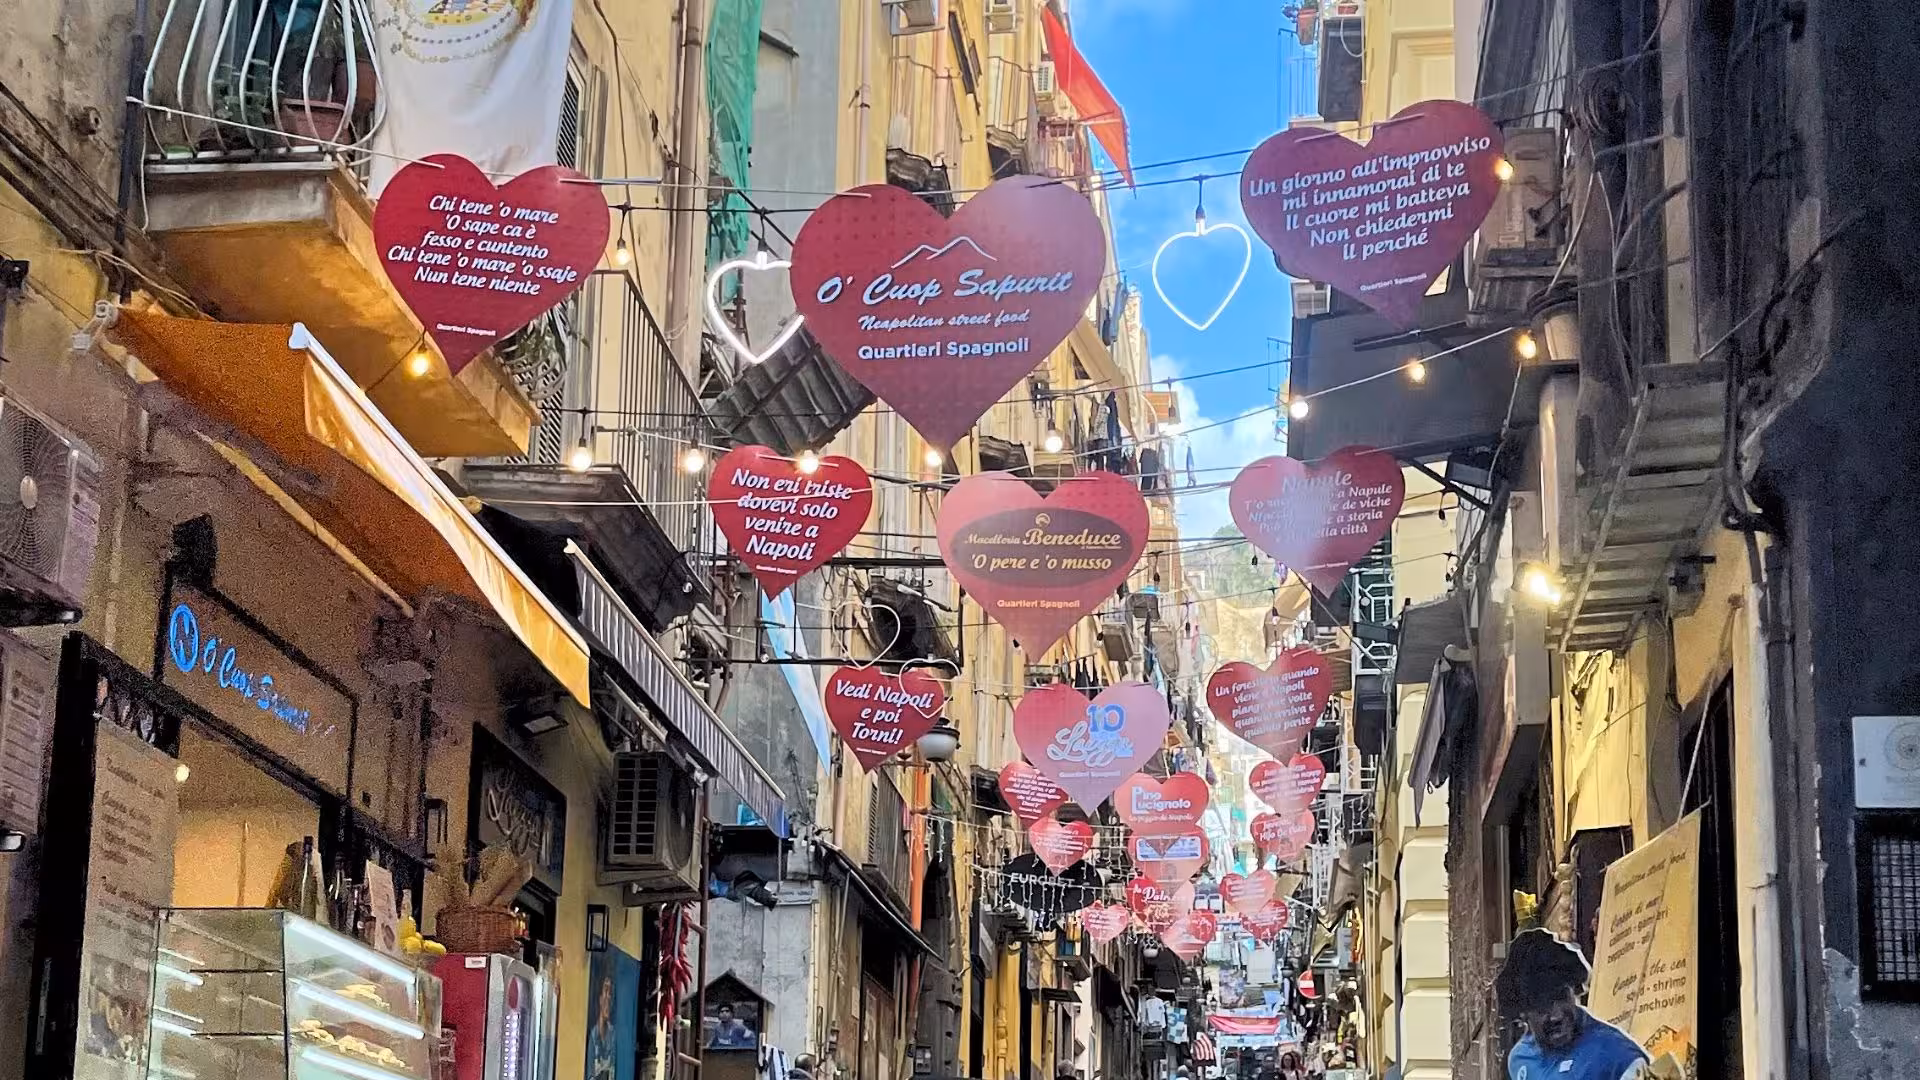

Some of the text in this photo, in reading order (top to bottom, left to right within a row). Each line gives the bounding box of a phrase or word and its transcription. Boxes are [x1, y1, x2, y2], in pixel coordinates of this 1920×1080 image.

[1250, 136, 1491, 196] Un giorno all'improvviso
[1283, 161, 1464, 211] mi innamorai di te
[430, 195, 558, 224] Chi tene 'o mare
[1286, 181, 1470, 230] Il cuore mi batteva
[445, 215, 536, 239] 'O sape ca è
[1310, 203, 1454, 247] Non chiedermi
[421, 231, 549, 259] fesso e cuntento
[1362, 227, 1429, 261] perché
[388, 246, 577, 284] Chi tene 'o mare 'o ssaje
[414, 266, 540, 295] Nun tene niente
[817, 268, 1073, 305] O' Cuop Sapurit
[858, 308, 1030, 332] Neapolitan street food
[859, 337, 1029, 360] Quartieri Spagnoli
[731, 468, 853, 499] Non eri triste
[1349, 483, 1392, 498] Napule
[737, 491, 838, 519] dovevi solo
[1343, 500, 1356, 510] de
[1360, 497, 1391, 508] viche
[744, 516, 819, 538] venire a
[1348, 511, 1383, 522] storia
[965, 528, 1121, 546] Macelleria Beneduce
[1341, 523, 1368, 535] città
[746, 535, 816, 561] Napoli
[971, 554, 1111, 572] 'O pere e 'o musso
[997, 600, 1080, 609] Quartieri Spagnoli
[1216, 686, 1229, 696] Un
[1282, 666, 1319, 682] quando
[836, 680, 934, 708] Vedi Napoli
[1288, 692, 1312, 704] volte
[861, 708, 902, 723] e poi
[1086, 703, 1126, 733] 10
[1284, 717, 1311, 731] parte
[852, 722, 903, 744] Torni!
[1650, 959, 1666, 976] the
[1671, 958, 1686, 970] sea
[1653, 976, 1686, 992] shrimp
[1639, 994, 1685, 1013] anchovies
